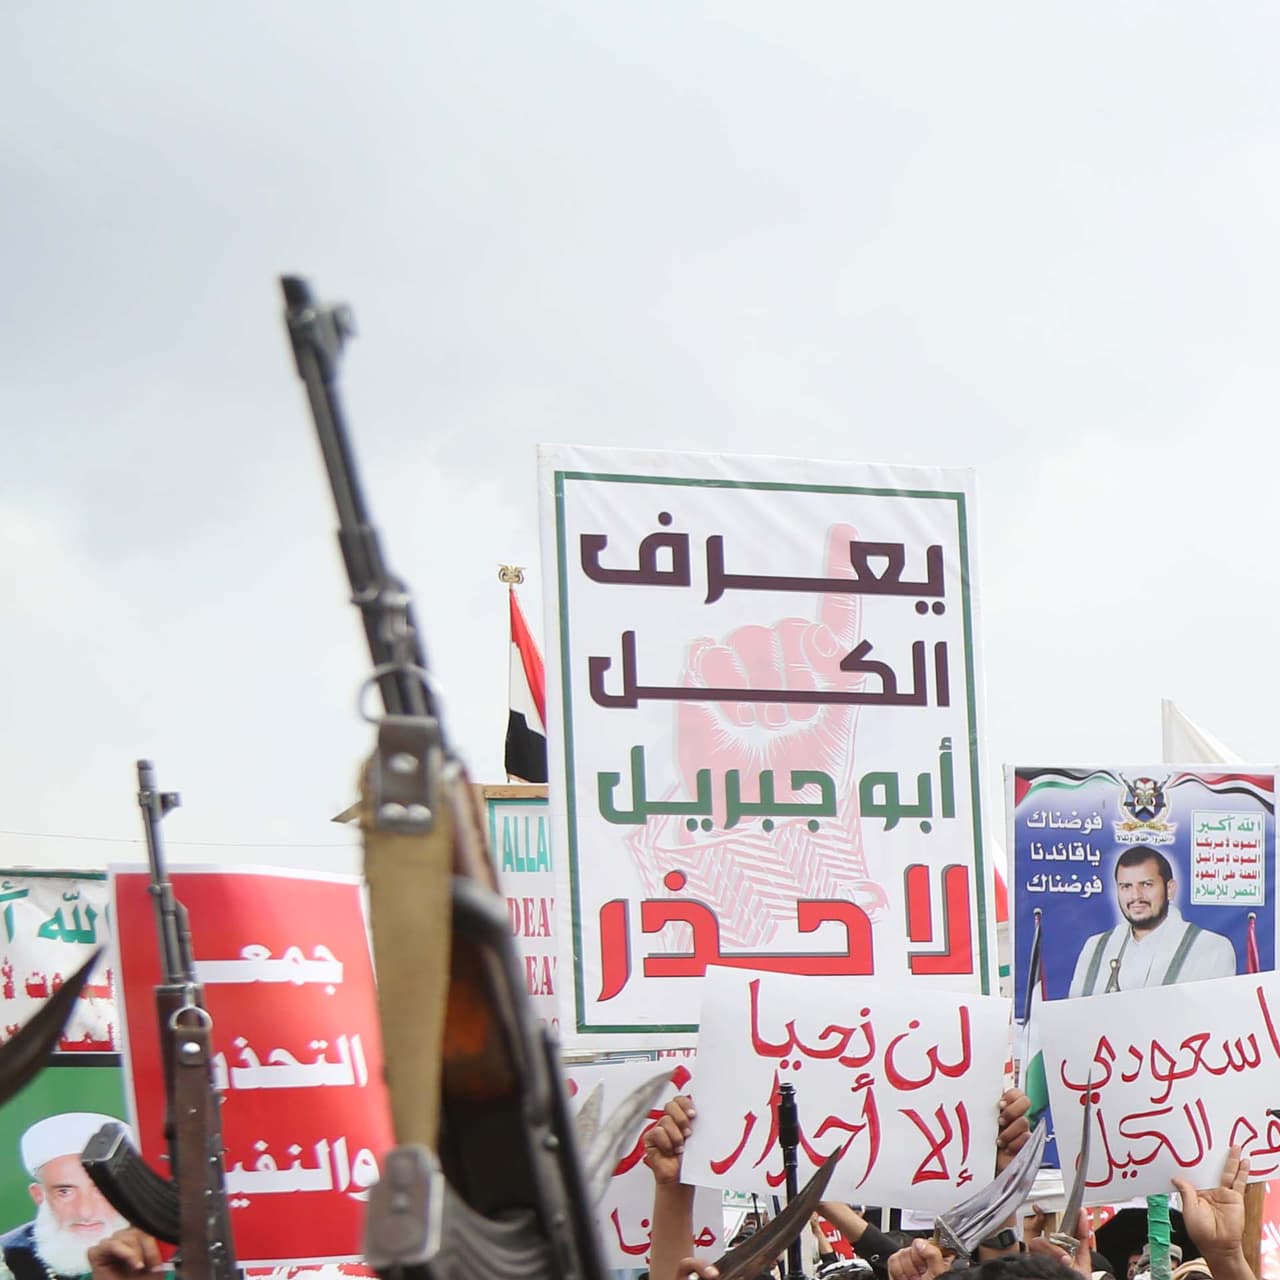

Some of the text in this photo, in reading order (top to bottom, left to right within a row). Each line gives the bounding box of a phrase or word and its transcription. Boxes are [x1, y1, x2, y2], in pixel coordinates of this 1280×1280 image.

[580, 511, 946, 617] يعرف
[588, 630, 950, 710] الكل
[597, 736, 956, 834] أبو جبريل
[1026, 810, 1104, 834] فوضناك
[502, 815, 551, 873] ALLA
[508, 897, 554, 938] DEA
[1026, 873, 1104, 899] فوضناك
[195, 943, 344, 995] جمع
[598, 863, 974, 1003] لا حذر
[748, 978, 973, 1092] لن نحيا
[709, 1067, 882, 1191] أحرار
[897, 1100, 974, 1189] إلا
[226, 1135, 381, 1209] والنفي
